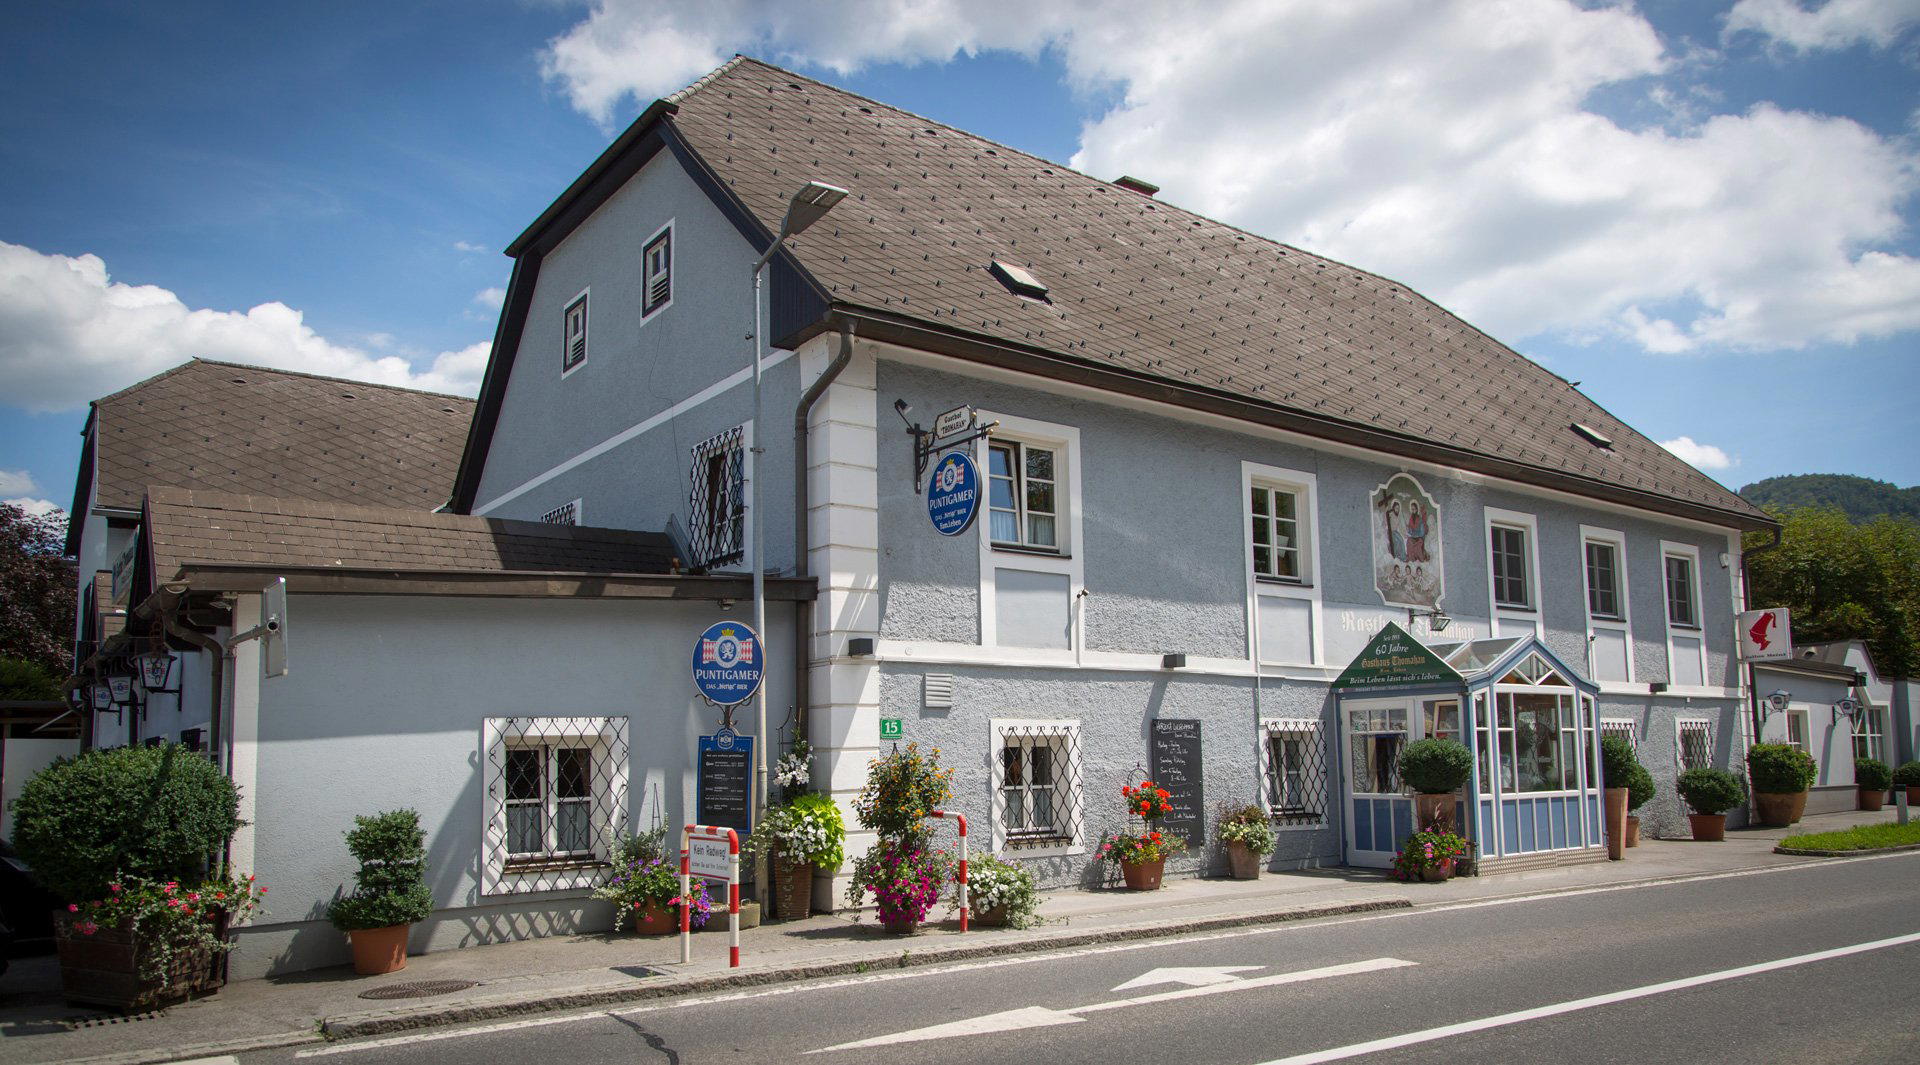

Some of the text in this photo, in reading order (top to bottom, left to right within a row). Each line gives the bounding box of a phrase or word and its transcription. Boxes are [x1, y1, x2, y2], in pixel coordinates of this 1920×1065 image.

[929, 489, 974, 511] PUNTIGAMER
[1375, 643, 1409, 655] 60 Jahre
[1361, 655, 1425, 668] Gasthaus Thomahan
[696, 669, 759, 680] PUNTIGAMER
[1366, 675, 1386, 684] Leben
[884, 721, 898, 734] 15
[693, 845, 704, 855] Kein
